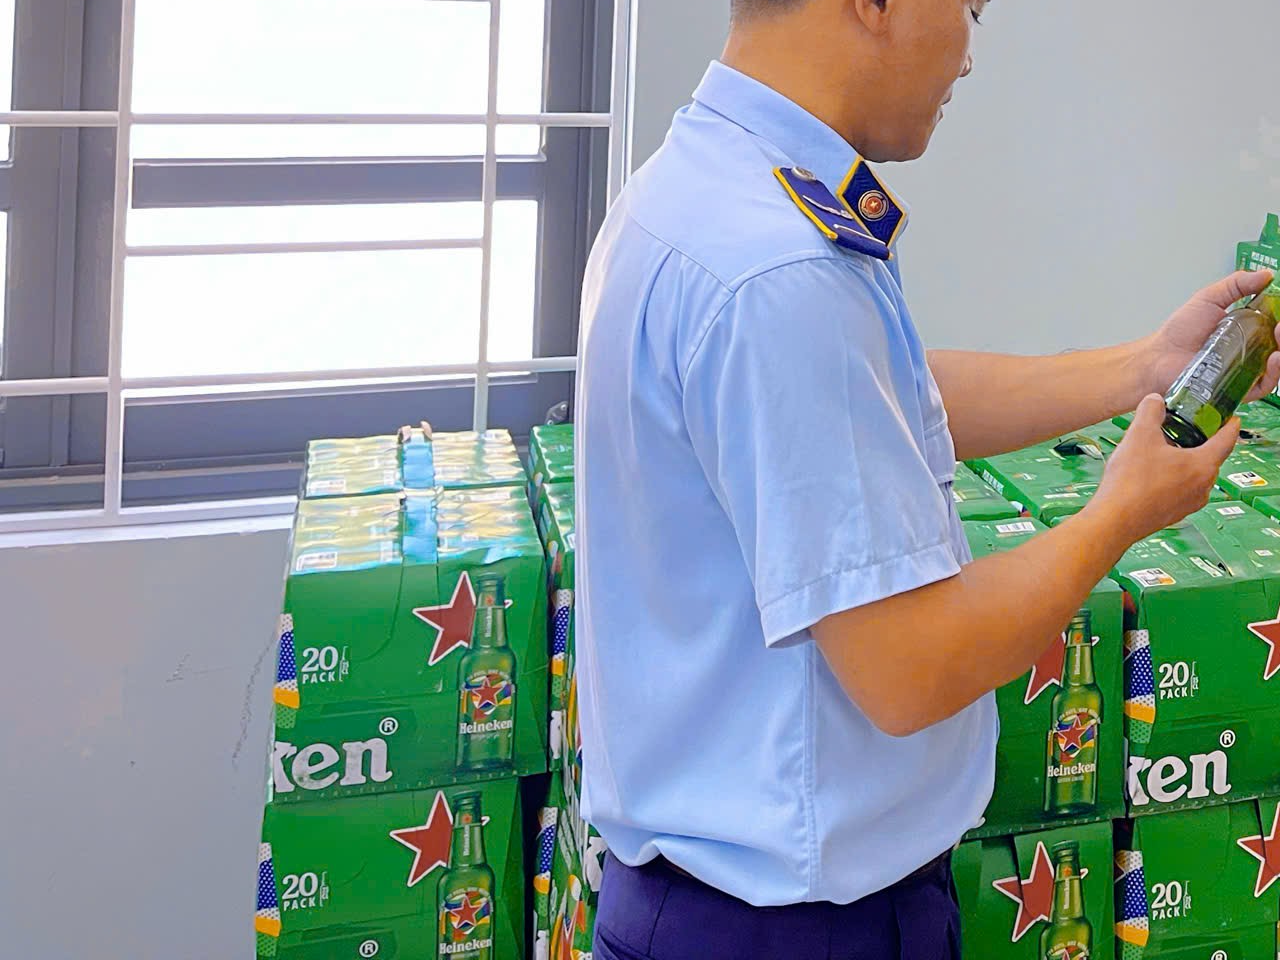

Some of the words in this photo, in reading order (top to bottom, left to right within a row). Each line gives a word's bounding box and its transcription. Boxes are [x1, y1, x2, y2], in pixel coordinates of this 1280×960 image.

[301, 645, 338, 672] 20
[302, 671, 336, 684] PACK
[1158, 661, 1189, 688] 20
[1160, 687, 1187, 700] PACK
[460, 720, 513, 734] Heineken
[1048, 763, 1096, 777] Heineken
[282, 873, 318, 899] 20
[1151, 881, 1182, 908] 20
[283, 898, 316, 911] PACK
[1153, 907, 1180, 920] PACK
[440, 938, 492, 954] Heineken
